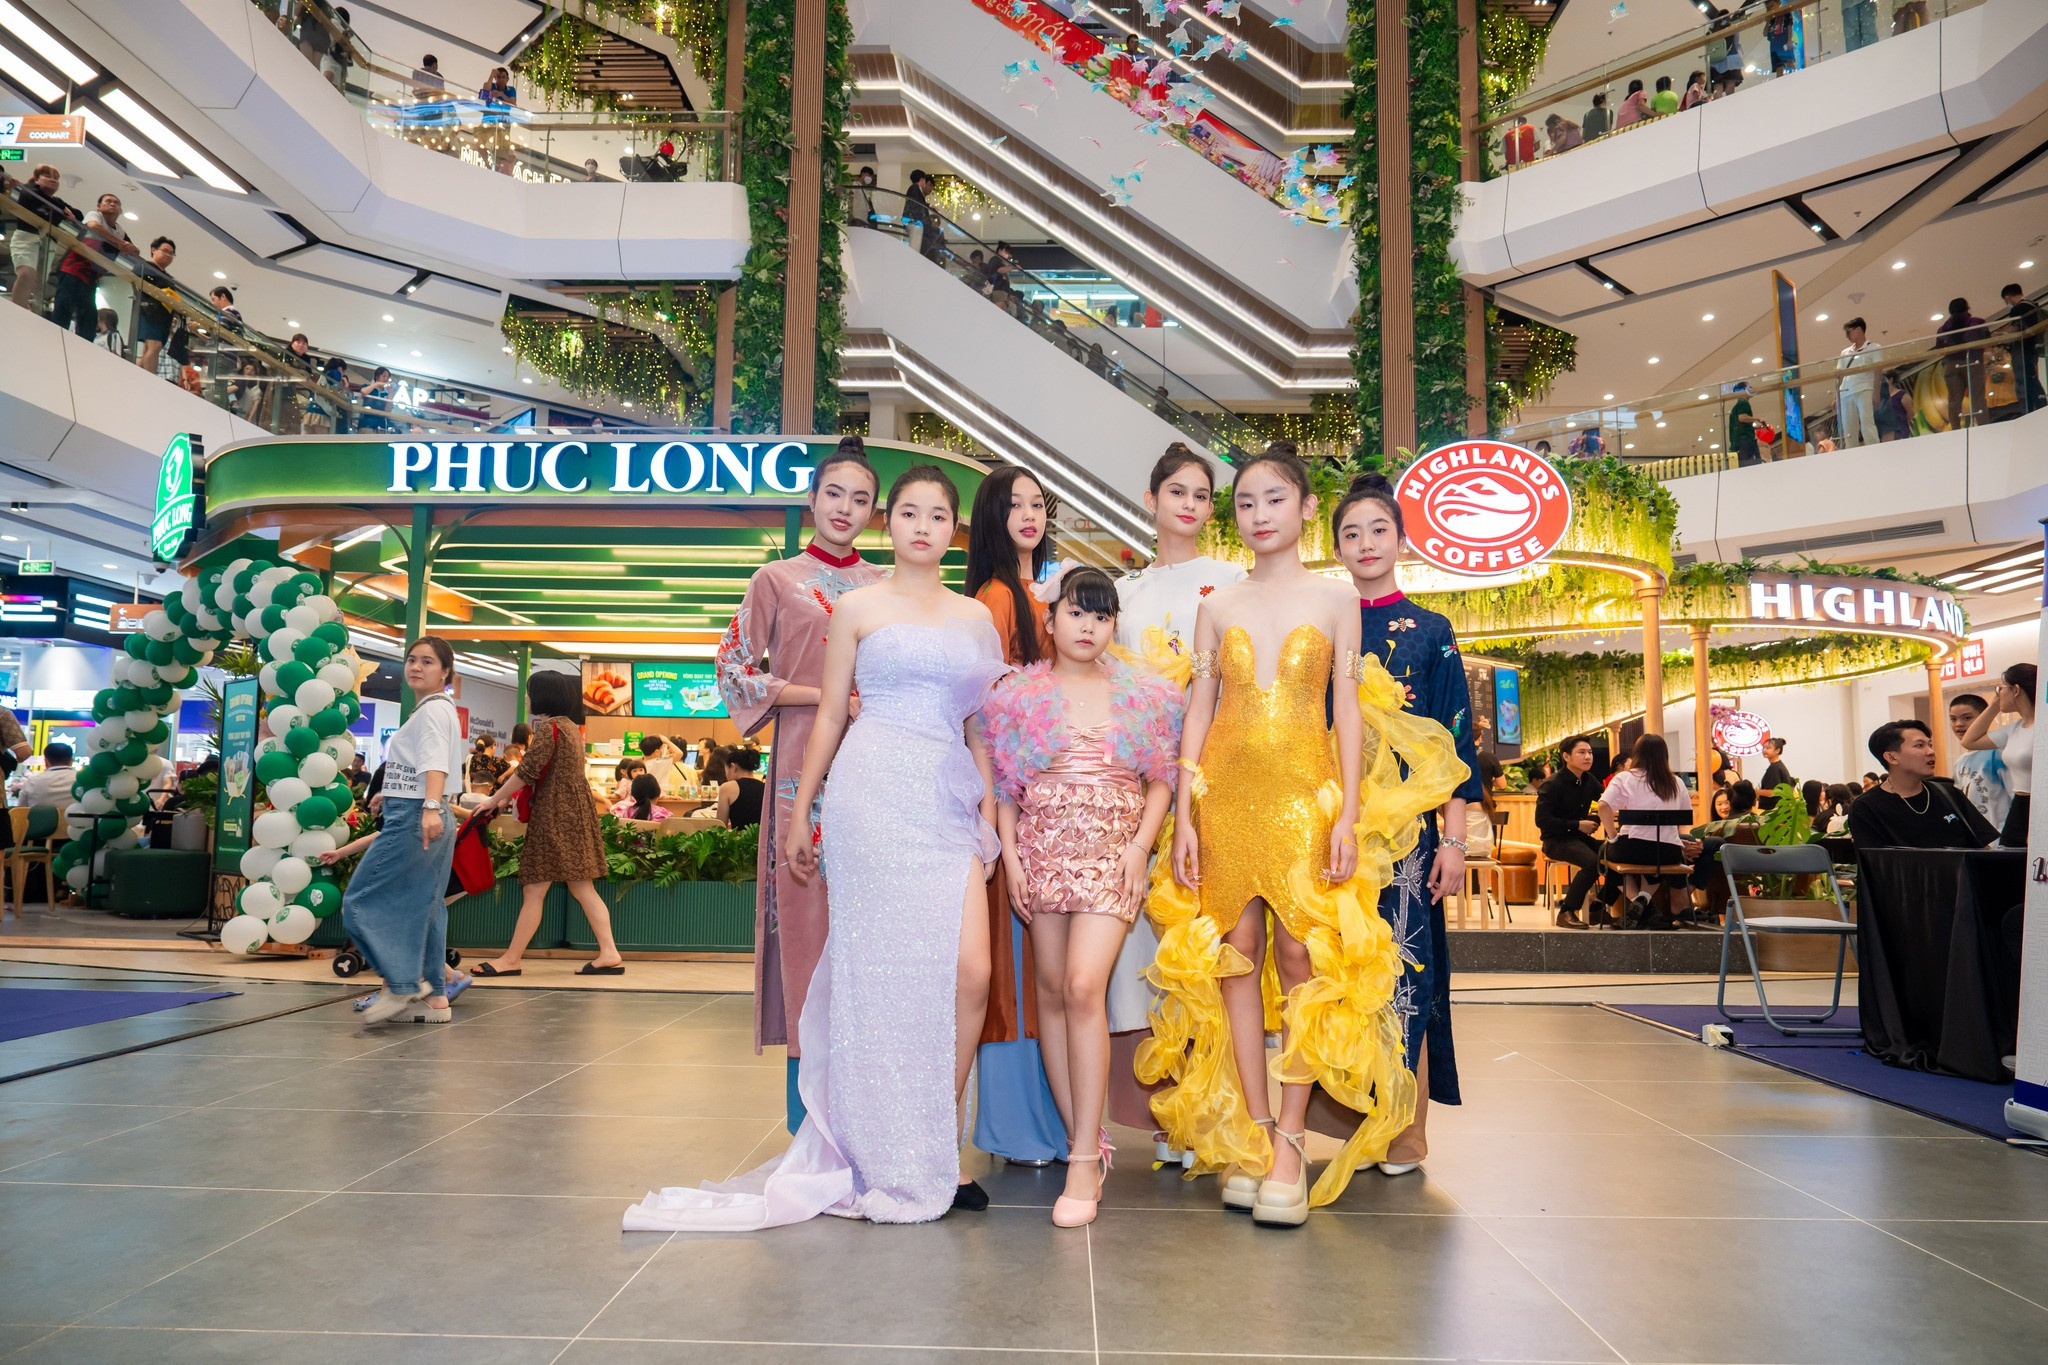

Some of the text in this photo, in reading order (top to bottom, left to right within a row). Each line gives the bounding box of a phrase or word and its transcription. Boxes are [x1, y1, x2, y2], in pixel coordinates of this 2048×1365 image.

[29, 131, 70, 139] COOPMART
[387, 441, 815, 495] PHUC LONG
[1404, 447, 1561, 501] HIGHLANDS
[152, 510, 172, 546] PHUC
[171, 502, 193, 528] LONG
[1424, 535, 1545, 568] COFFEE
[1750, 582, 1965, 638] HIGHLAND
[1962, 643, 1981, 659] UNI
[1963, 657, 1984, 674] QLO
[469, 715, 495, 728] McDonald's
[469, 725, 486, 735] Vincom
[1722, 742, 1764, 755] COFFEE
